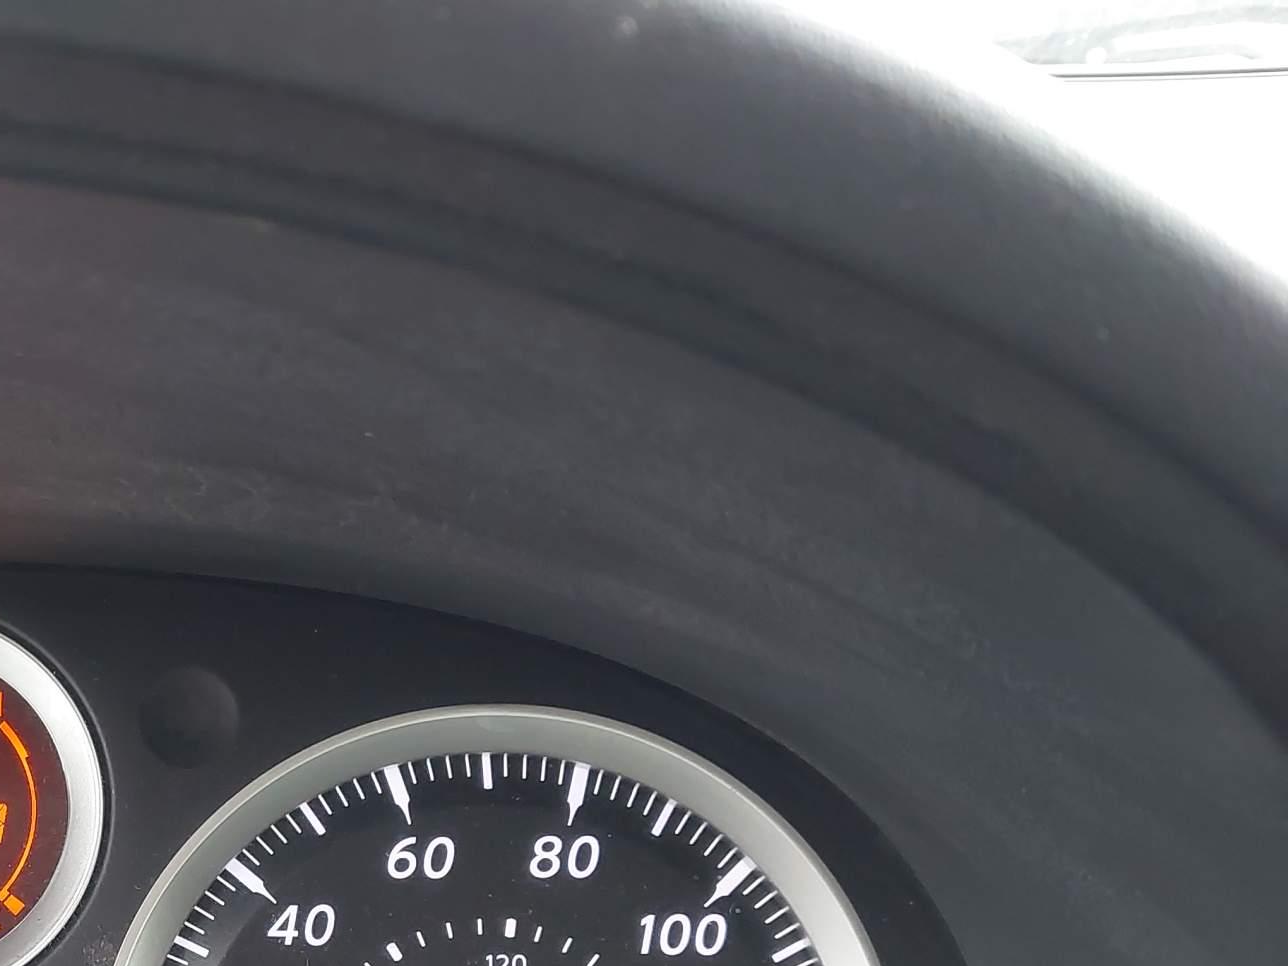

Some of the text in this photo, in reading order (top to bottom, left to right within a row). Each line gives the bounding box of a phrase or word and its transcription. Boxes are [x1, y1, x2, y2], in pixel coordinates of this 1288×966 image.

[386, 836, 456, 880] 60
[528, 836, 600, 879] 80
[267, 904, 336, 947] 40
[639, 914, 728, 957] 100
